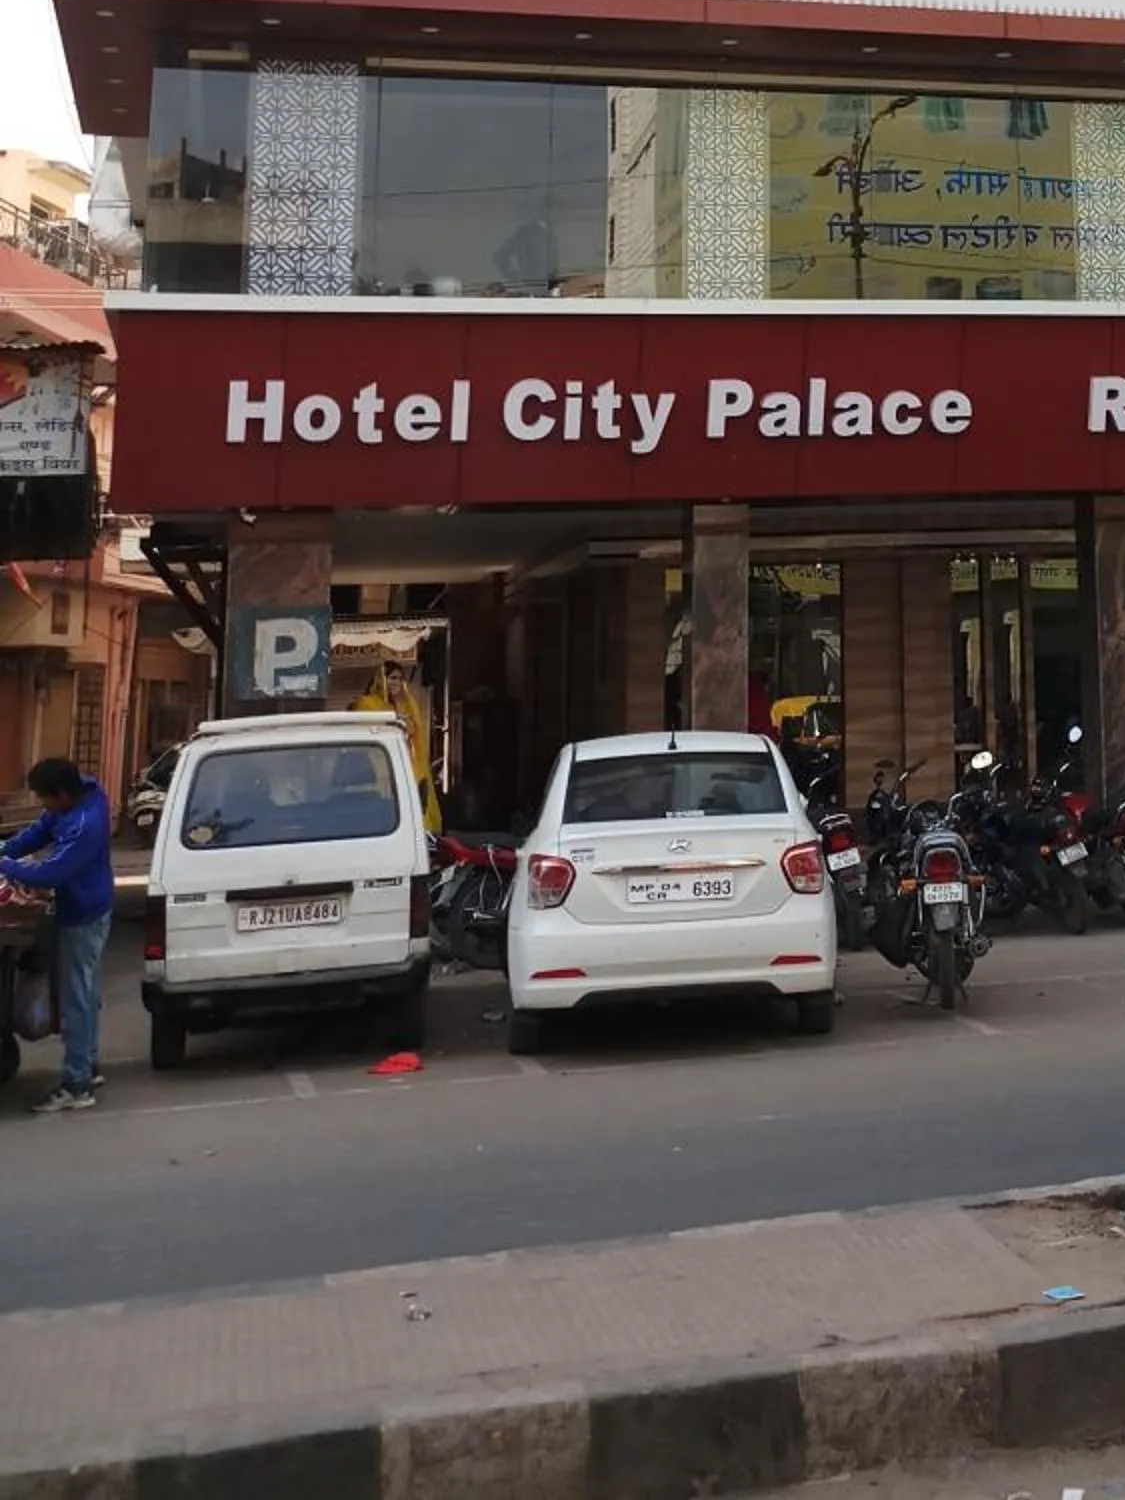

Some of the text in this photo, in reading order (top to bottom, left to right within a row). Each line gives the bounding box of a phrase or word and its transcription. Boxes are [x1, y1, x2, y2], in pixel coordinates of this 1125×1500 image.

[225, 379, 470, 444] Hotel
[503, 377, 677, 453] City
[706, 377, 974, 439] Palace
[254, 618, 320, 696] P
[693, 879, 731, 898] 6393
